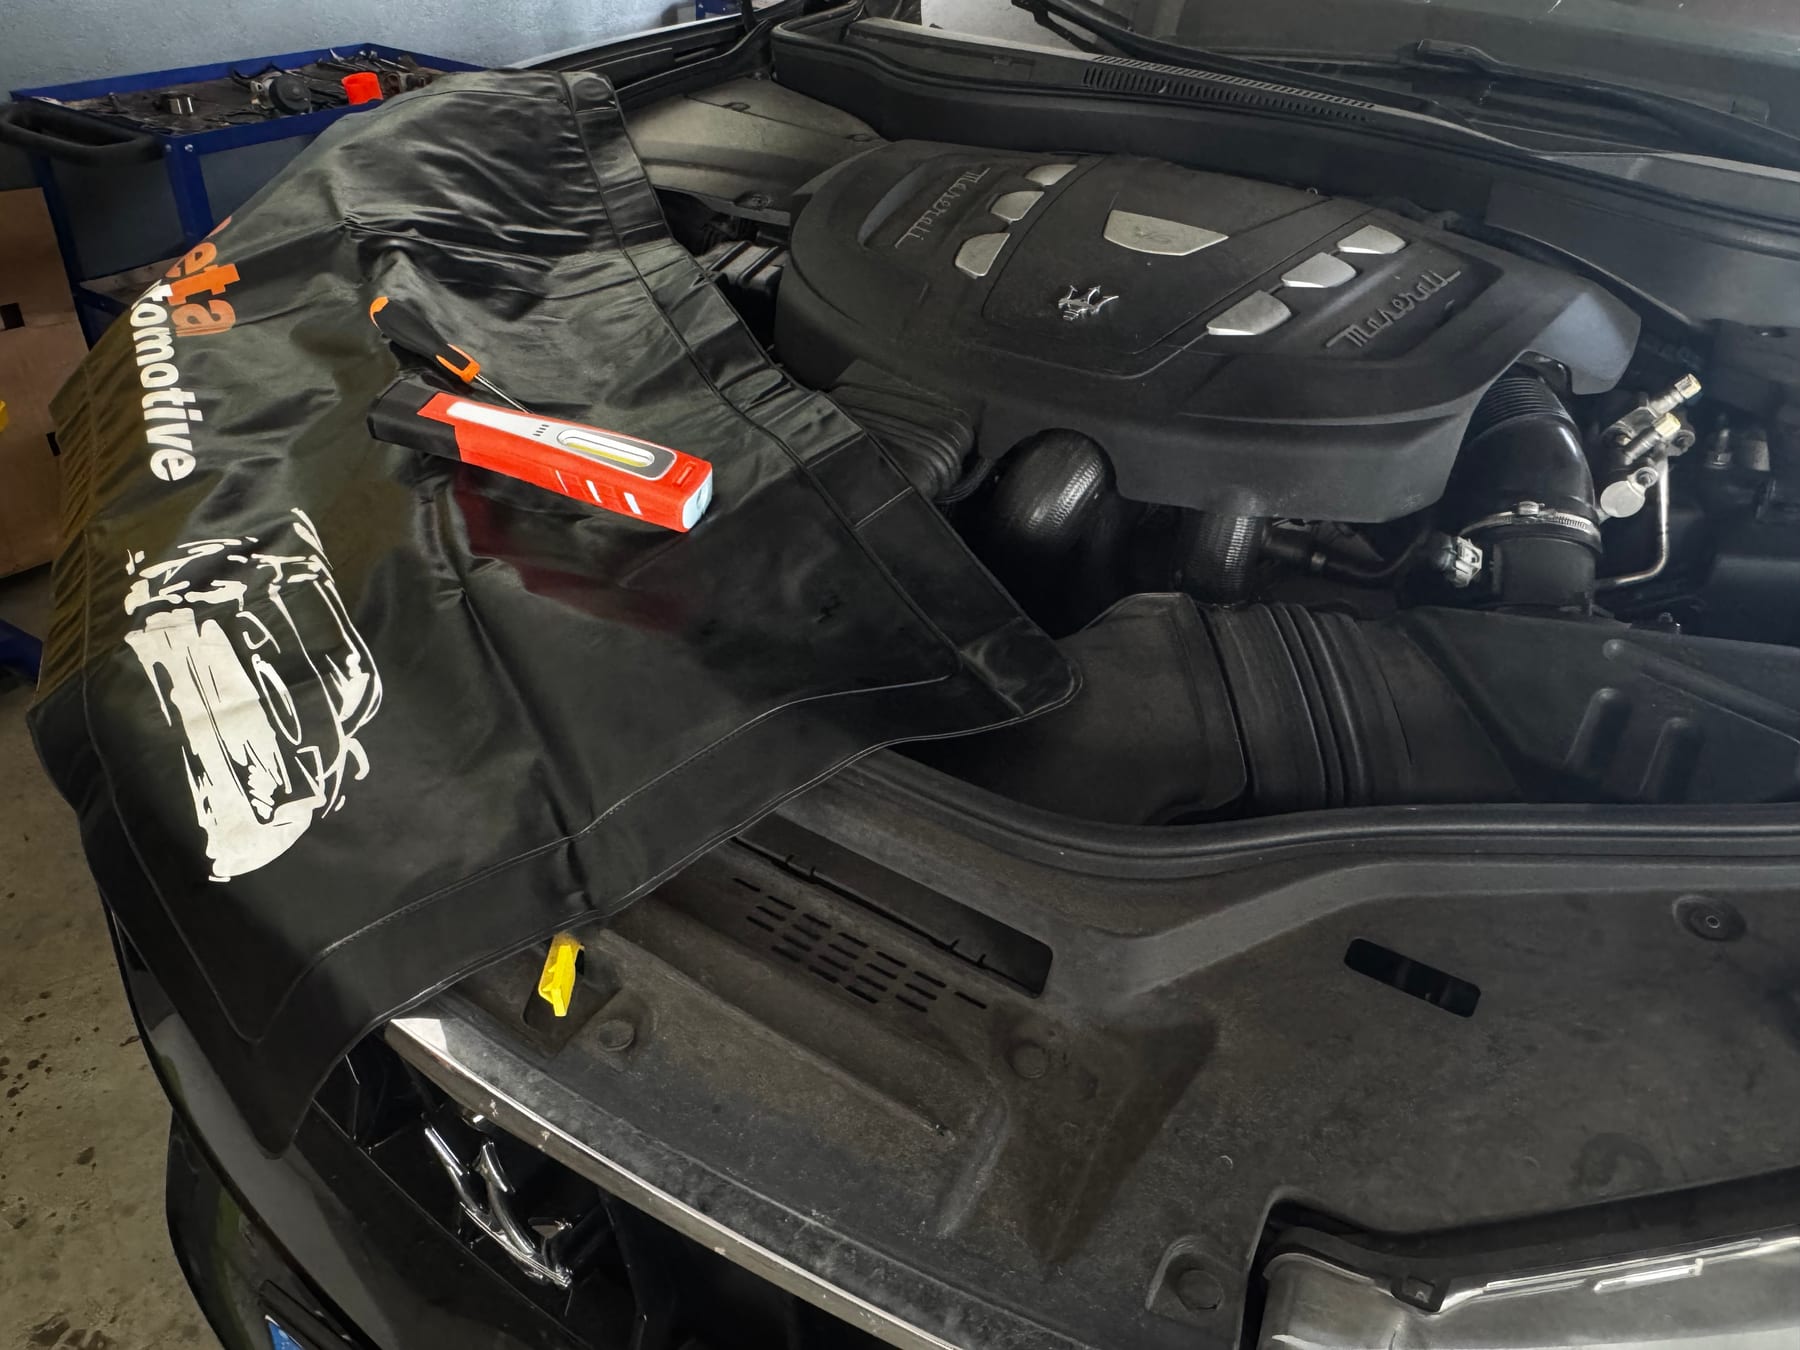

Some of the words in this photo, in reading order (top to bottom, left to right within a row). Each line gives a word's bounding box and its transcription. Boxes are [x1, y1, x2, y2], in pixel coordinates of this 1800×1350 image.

[165, 216, 240, 337] eta
[1325, 269, 1461, 348] Maserati
[130, 279, 203, 481] tomotive
